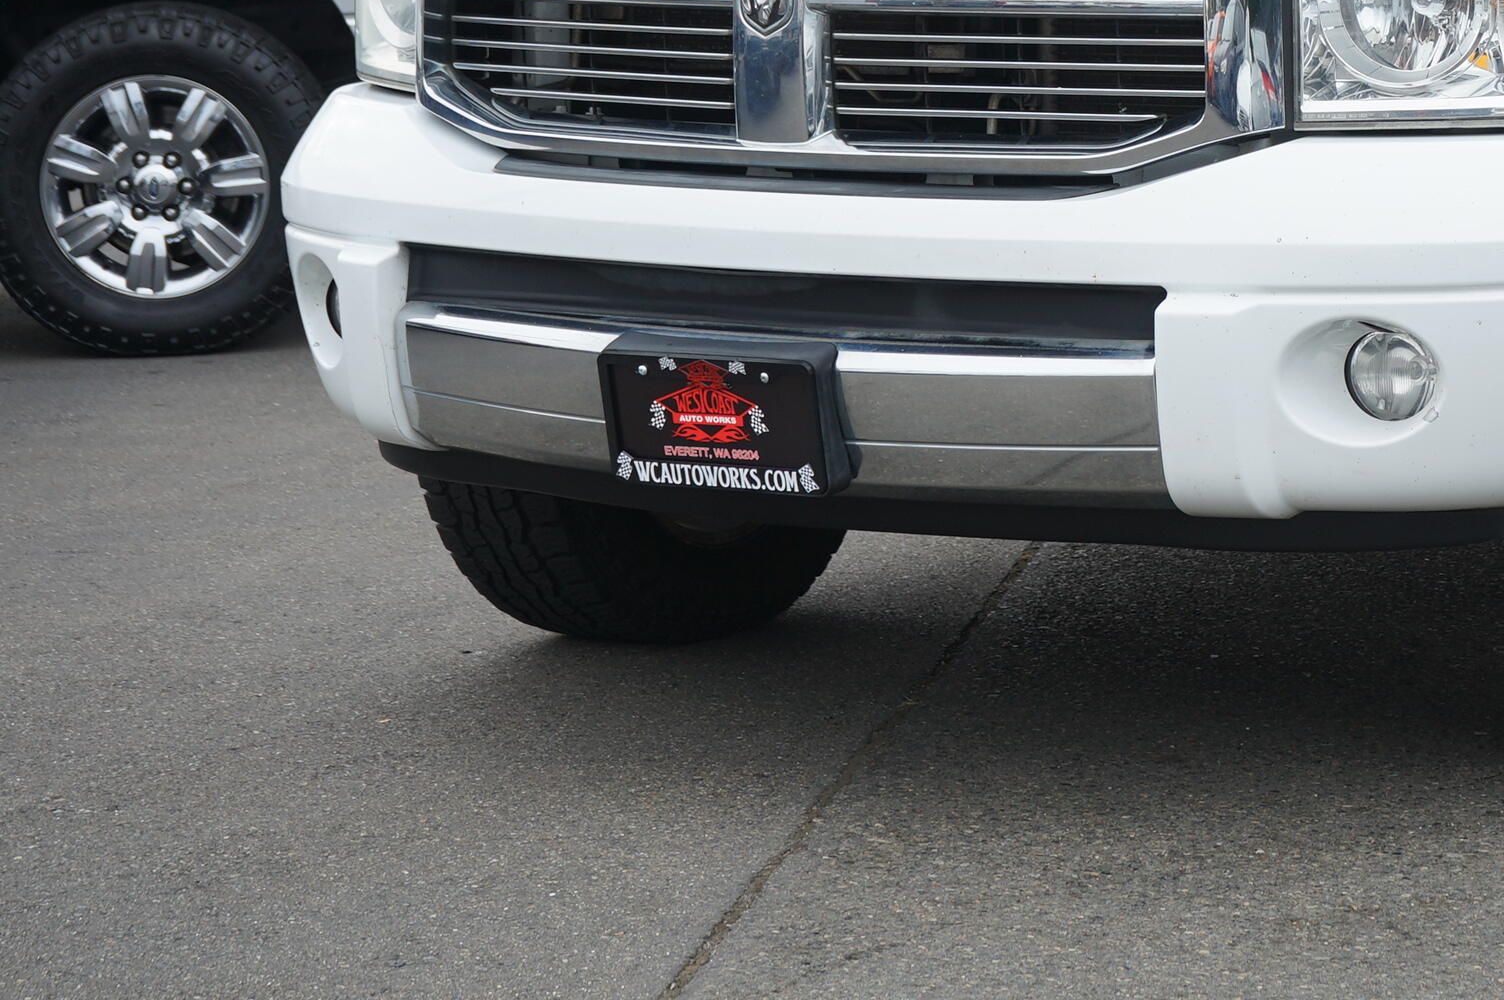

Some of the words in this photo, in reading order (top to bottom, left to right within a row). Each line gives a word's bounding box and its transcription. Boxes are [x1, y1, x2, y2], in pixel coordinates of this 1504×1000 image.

[703, 388, 739, 415] COAST
[679, 414, 704, 423] AUTO
[704, 415, 737, 425] WORKS
[664, 446, 712, 459] EVERETT,
[713, 448, 730, 458] WA
[634, 460, 799, 492] WCAUTOWORKS.COM
